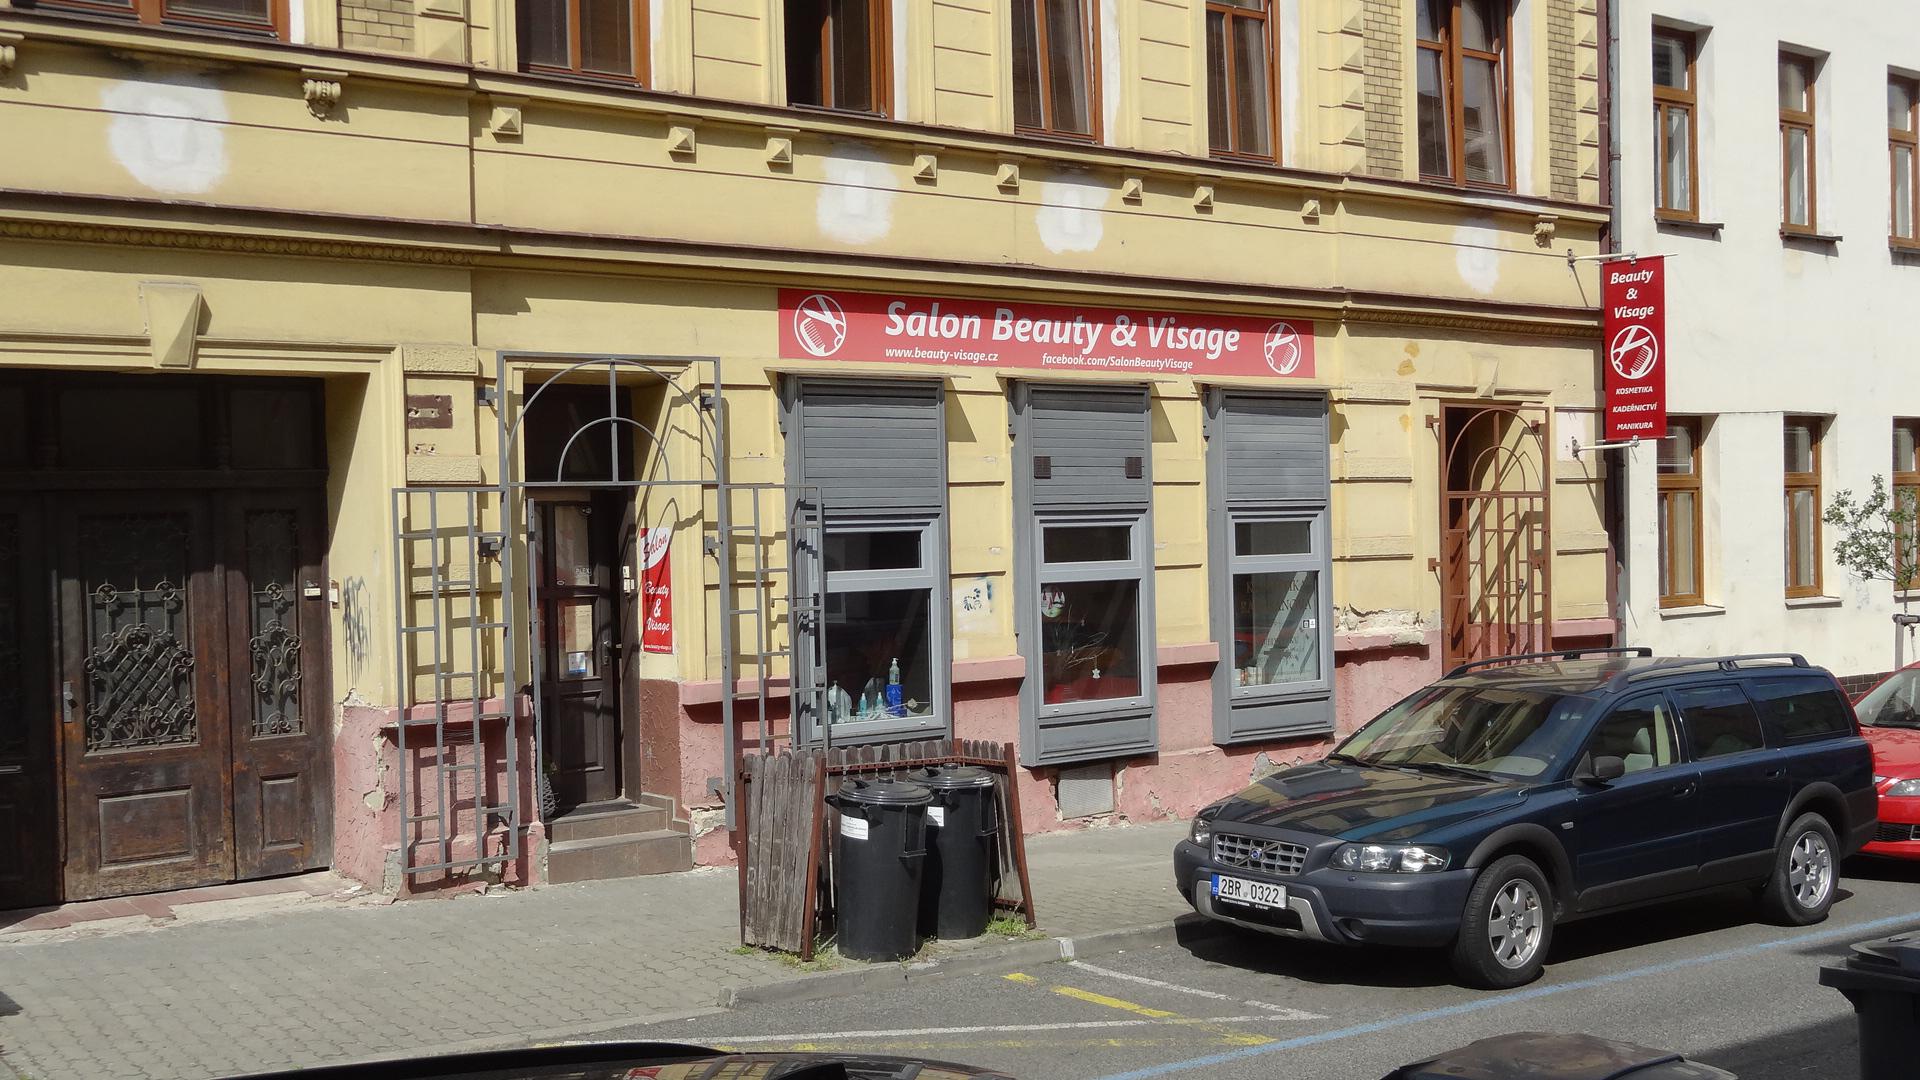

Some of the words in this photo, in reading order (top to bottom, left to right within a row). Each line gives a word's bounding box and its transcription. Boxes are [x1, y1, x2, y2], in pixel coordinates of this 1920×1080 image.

[1610, 269, 1654, 284] Beauty
[1626, 287, 1638, 300] &
[1614, 305, 1654, 320] Visage
[885, 300, 981, 340] Salon
[992, 307, 1103, 355] Beauty
[1110, 314, 1138, 347] &
[1147, 316, 1240, 360] Visage
[885, 347, 998, 363] www.beauty-visage.cz
[1042, 352, 1193, 372] facebook.com/SalonBeautyVisage
[1615, 385, 1653, 395] KOSMETIKA
[1616, 421, 1653, 431] MANIKURA
[645, 581, 669, 599] Beauty
[653, 598, 662, 618] &
[646, 617, 670, 636] Visage
[1221, 879, 1242, 897] 2BR
[1250, 884, 1279, 905] 0322
